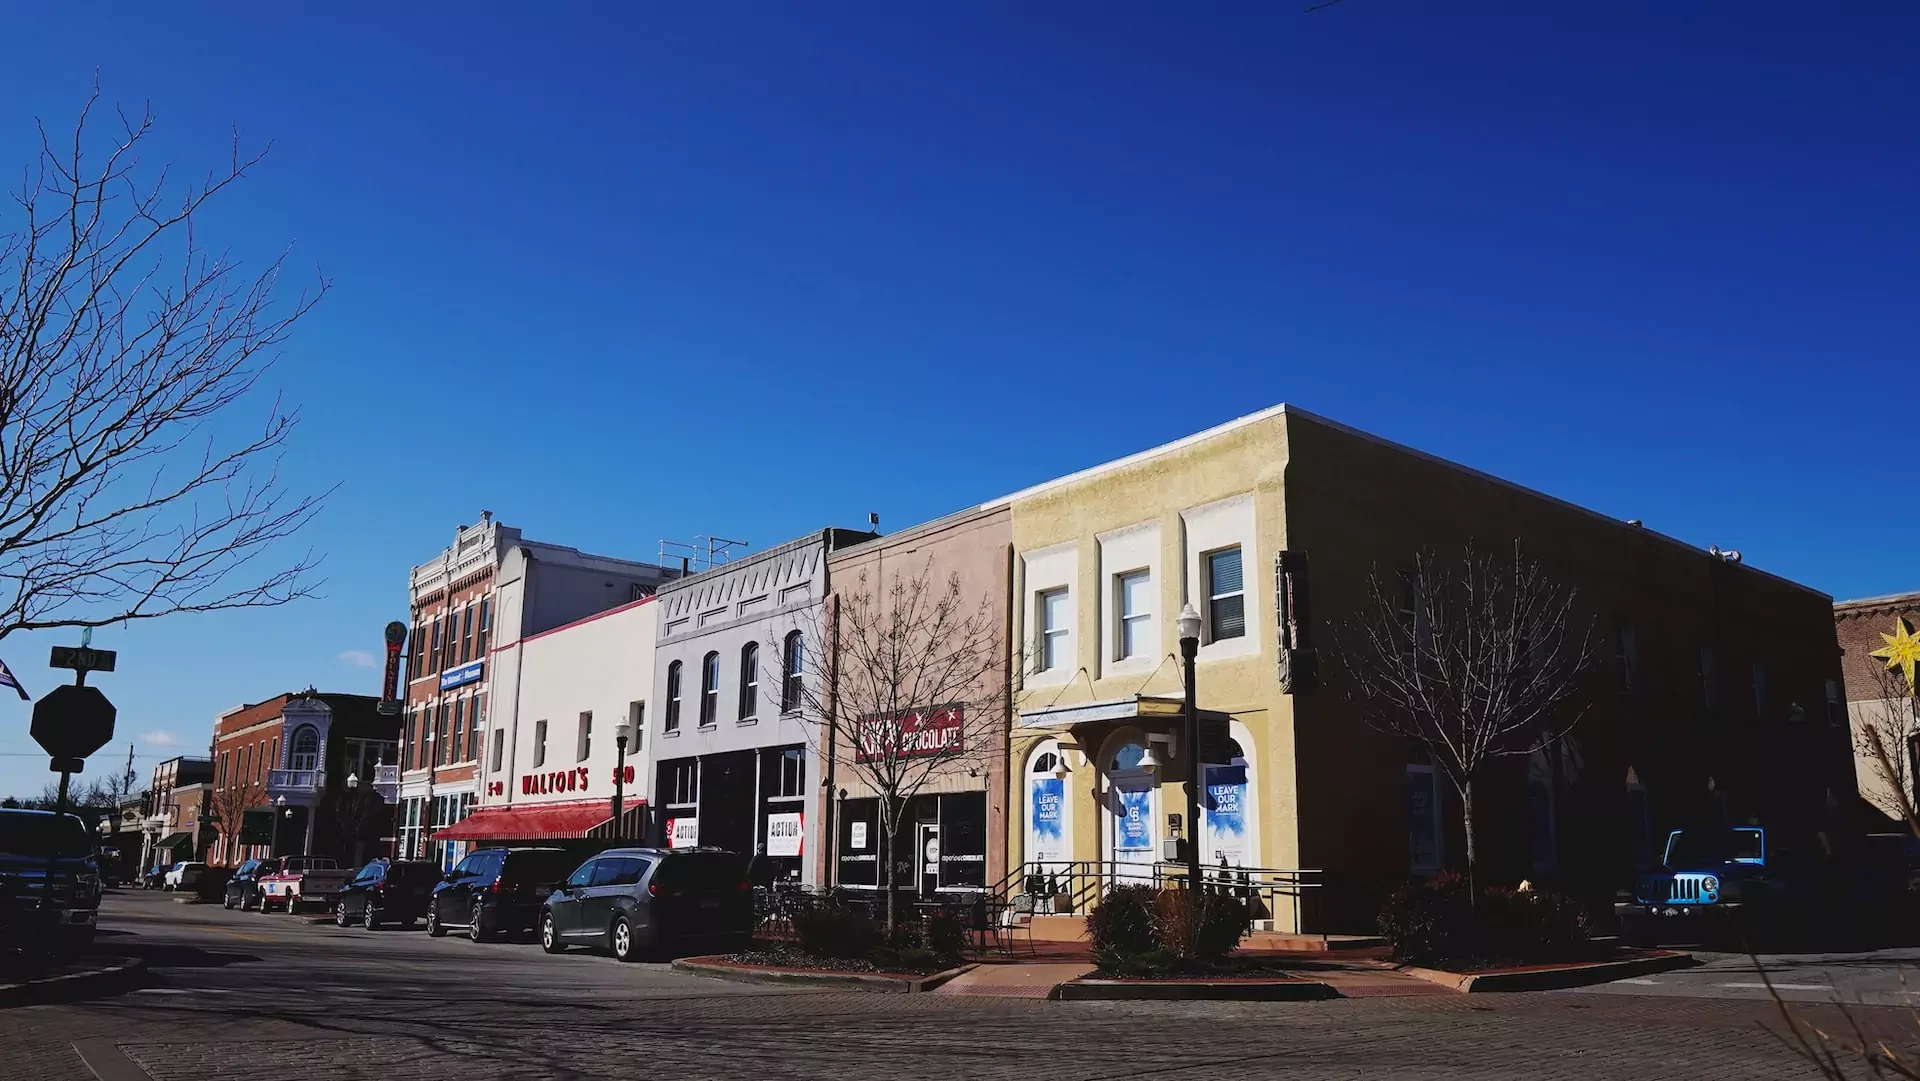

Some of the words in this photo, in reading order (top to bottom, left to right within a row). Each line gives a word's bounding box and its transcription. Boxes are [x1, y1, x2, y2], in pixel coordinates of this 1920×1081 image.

[522, 767, 588, 796] WALTON'S
[1214, 786, 1239, 796] LEAVE
[1039, 796, 1059, 804] LEAVE
[1217, 795, 1236, 803] OUR
[1041, 804, 1056, 812] OUR
[1215, 803, 1239, 812] MARK
[1039, 811, 1058, 820] MARK
[771, 821, 798, 837] ACTION
